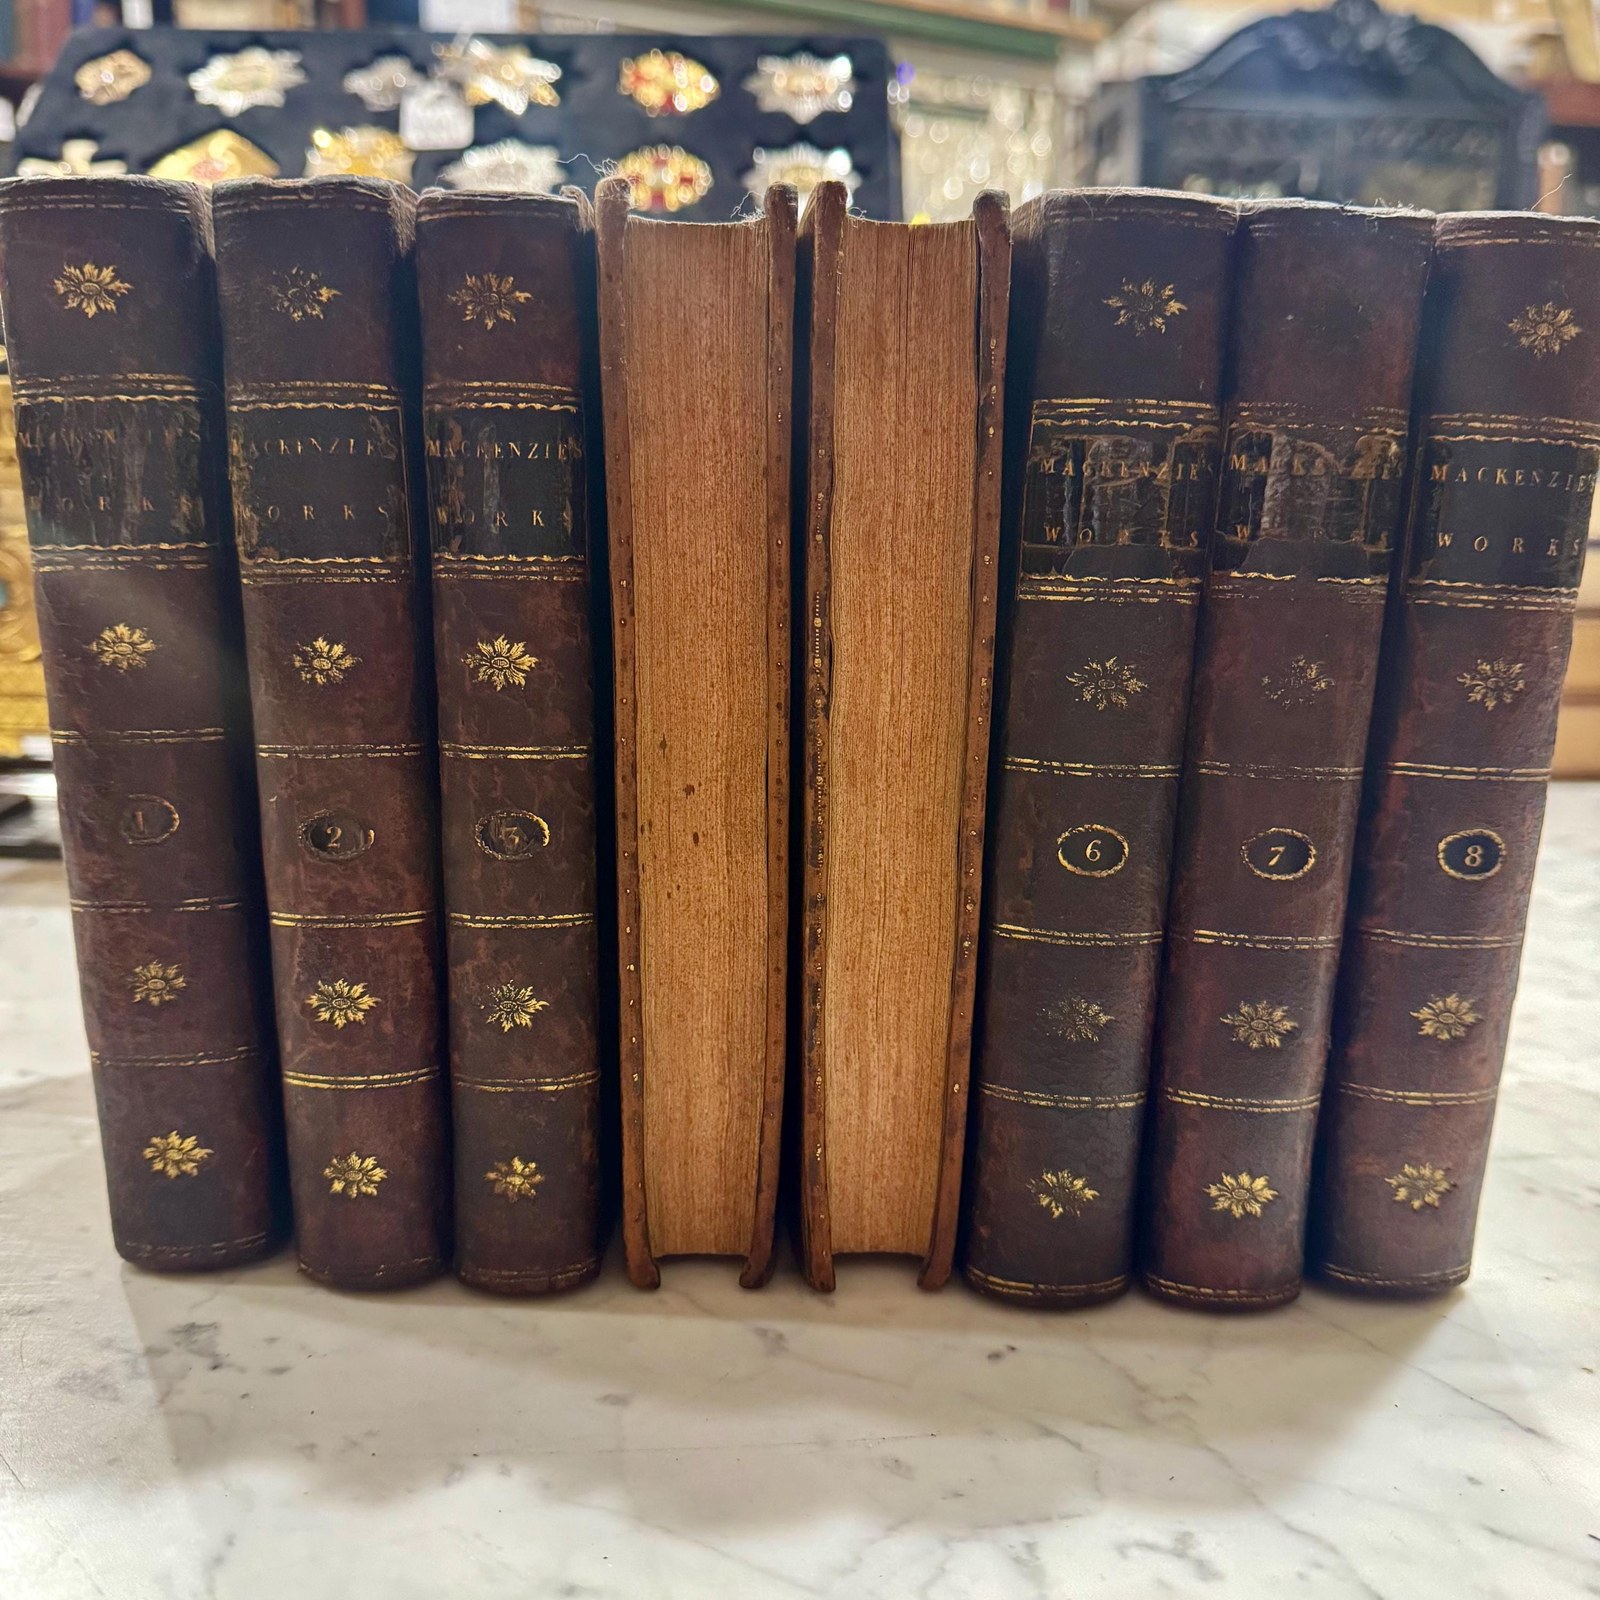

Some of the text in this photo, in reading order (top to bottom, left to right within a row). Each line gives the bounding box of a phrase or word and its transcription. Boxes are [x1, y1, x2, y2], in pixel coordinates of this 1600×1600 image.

[1437, 532, 1581, 556] WORKS
[326, 826, 342, 848] 2
[1085, 839, 1101, 862] 6
[1268, 845, 1286, 867] 7
[1464, 845, 1483, 867] 8
